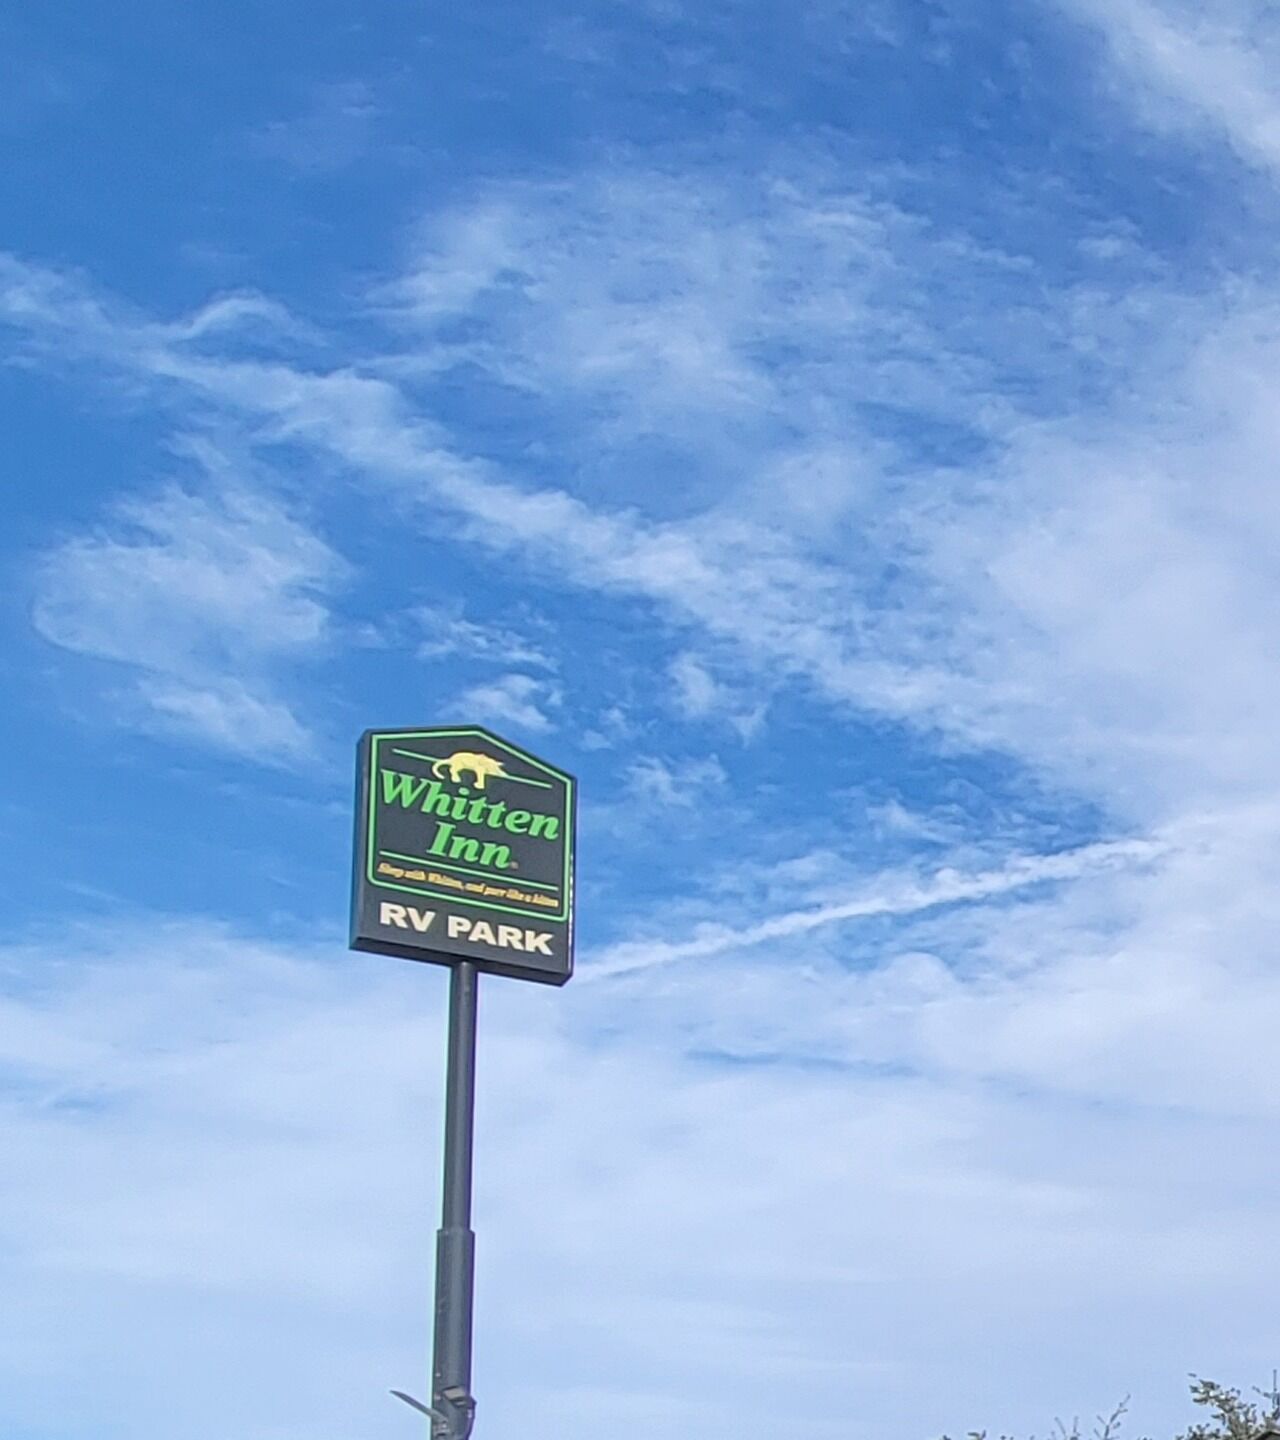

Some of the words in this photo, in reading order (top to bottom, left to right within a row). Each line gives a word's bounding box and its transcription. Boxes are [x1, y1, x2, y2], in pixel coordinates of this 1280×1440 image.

[380, 768, 559, 840] Whitten
[426, 821, 512, 869] Inn
[380, 902, 436, 932] RV
[447, 915, 554, 955] PARK
